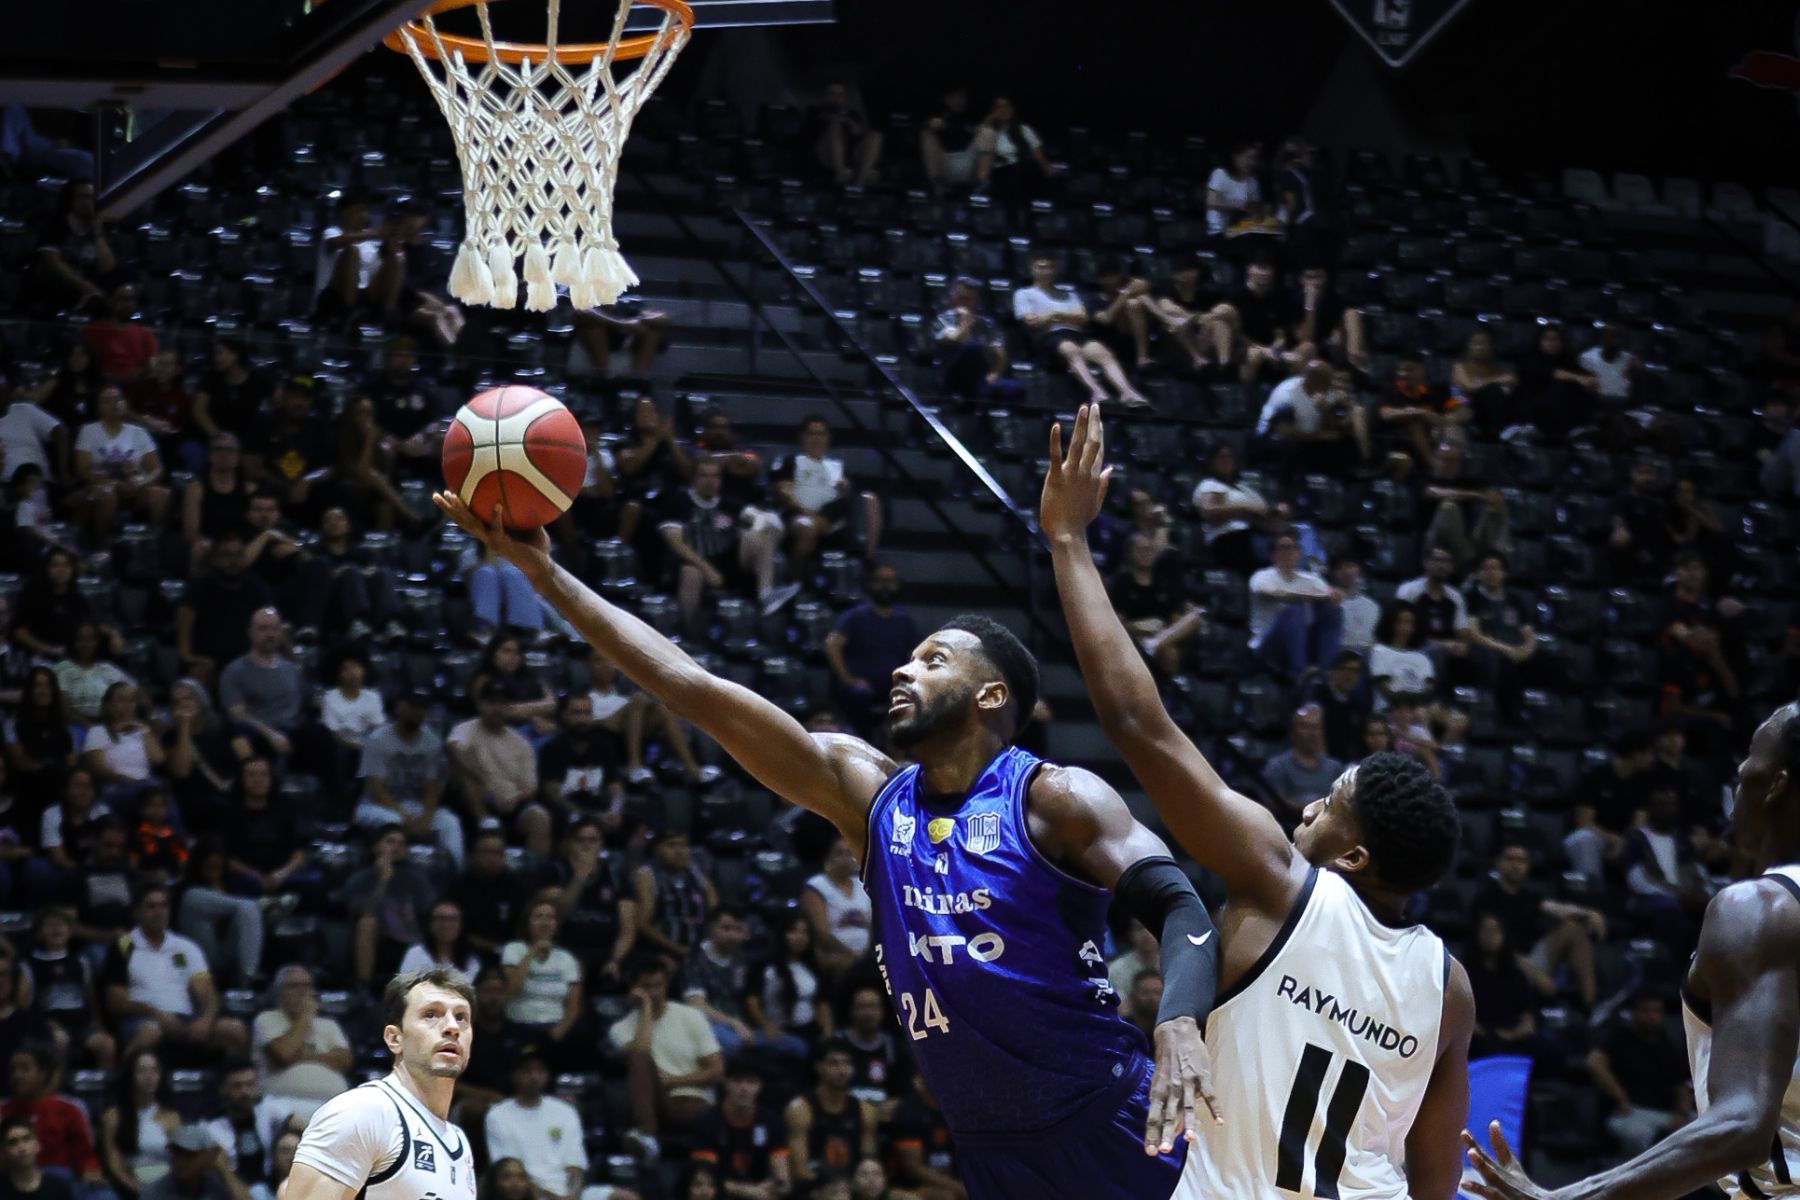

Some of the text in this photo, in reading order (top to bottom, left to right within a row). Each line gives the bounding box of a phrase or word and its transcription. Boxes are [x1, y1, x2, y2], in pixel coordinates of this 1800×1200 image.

[908, 932, 1004, 964] KTO
[902, 988, 949, 1040] 24
[1277, 975, 1418, 1058] RAYMUNDO
[1275, 1042, 1370, 1200] 11
